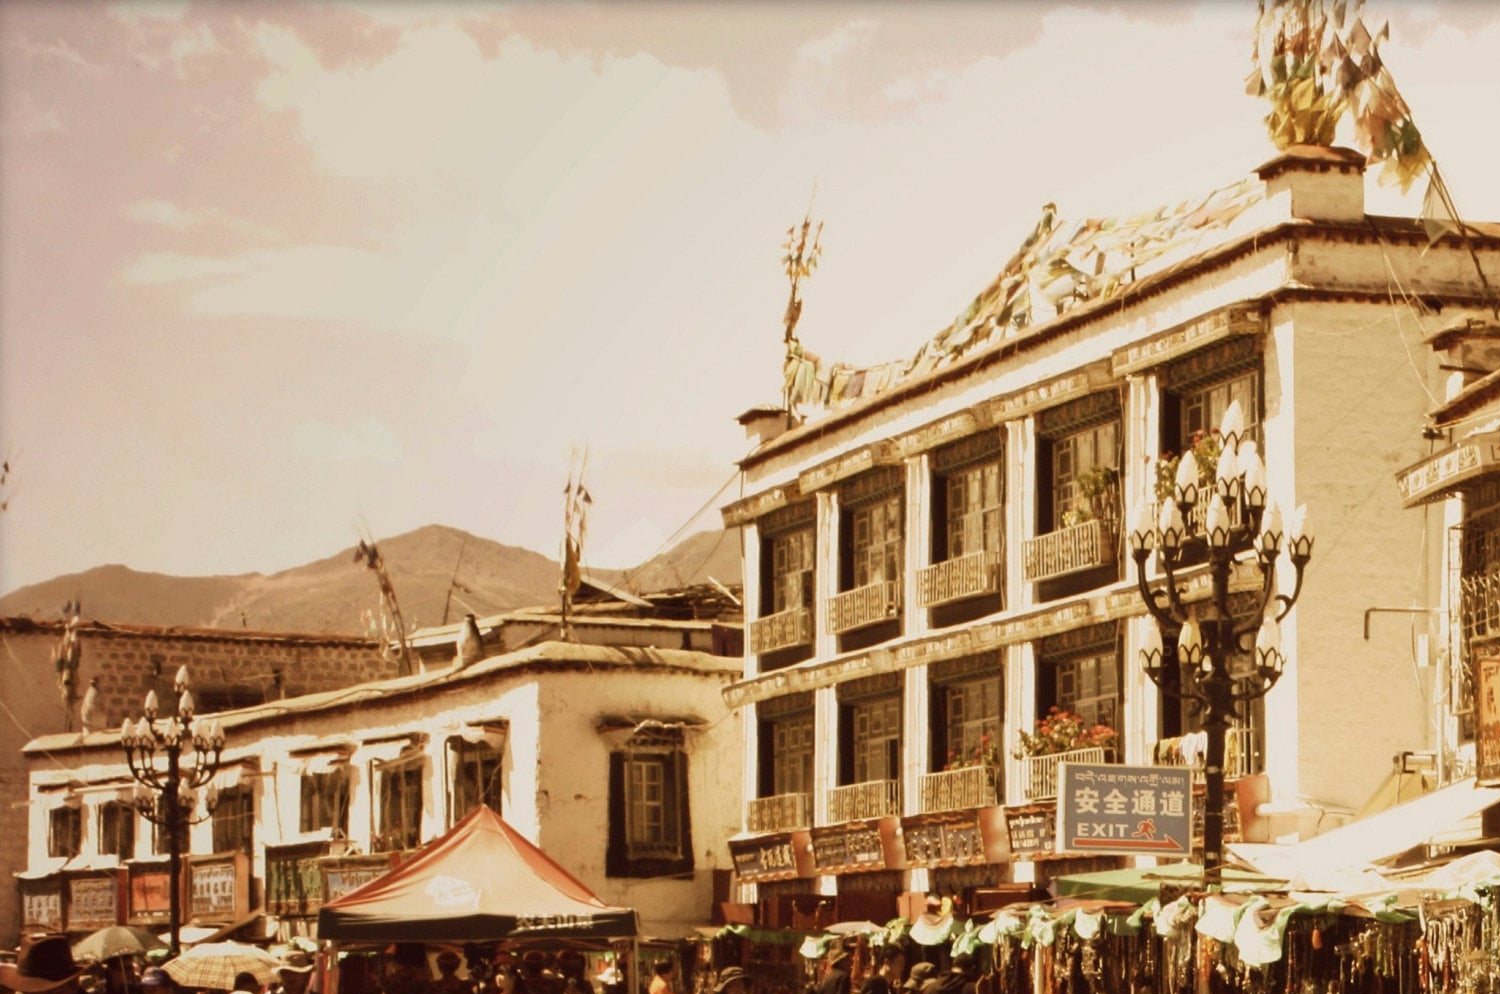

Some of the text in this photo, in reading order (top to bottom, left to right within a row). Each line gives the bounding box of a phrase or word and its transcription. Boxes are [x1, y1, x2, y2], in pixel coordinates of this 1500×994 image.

[1074, 787, 1185, 817] 安全通道
[1076, 822, 1129, 838] EXIT
